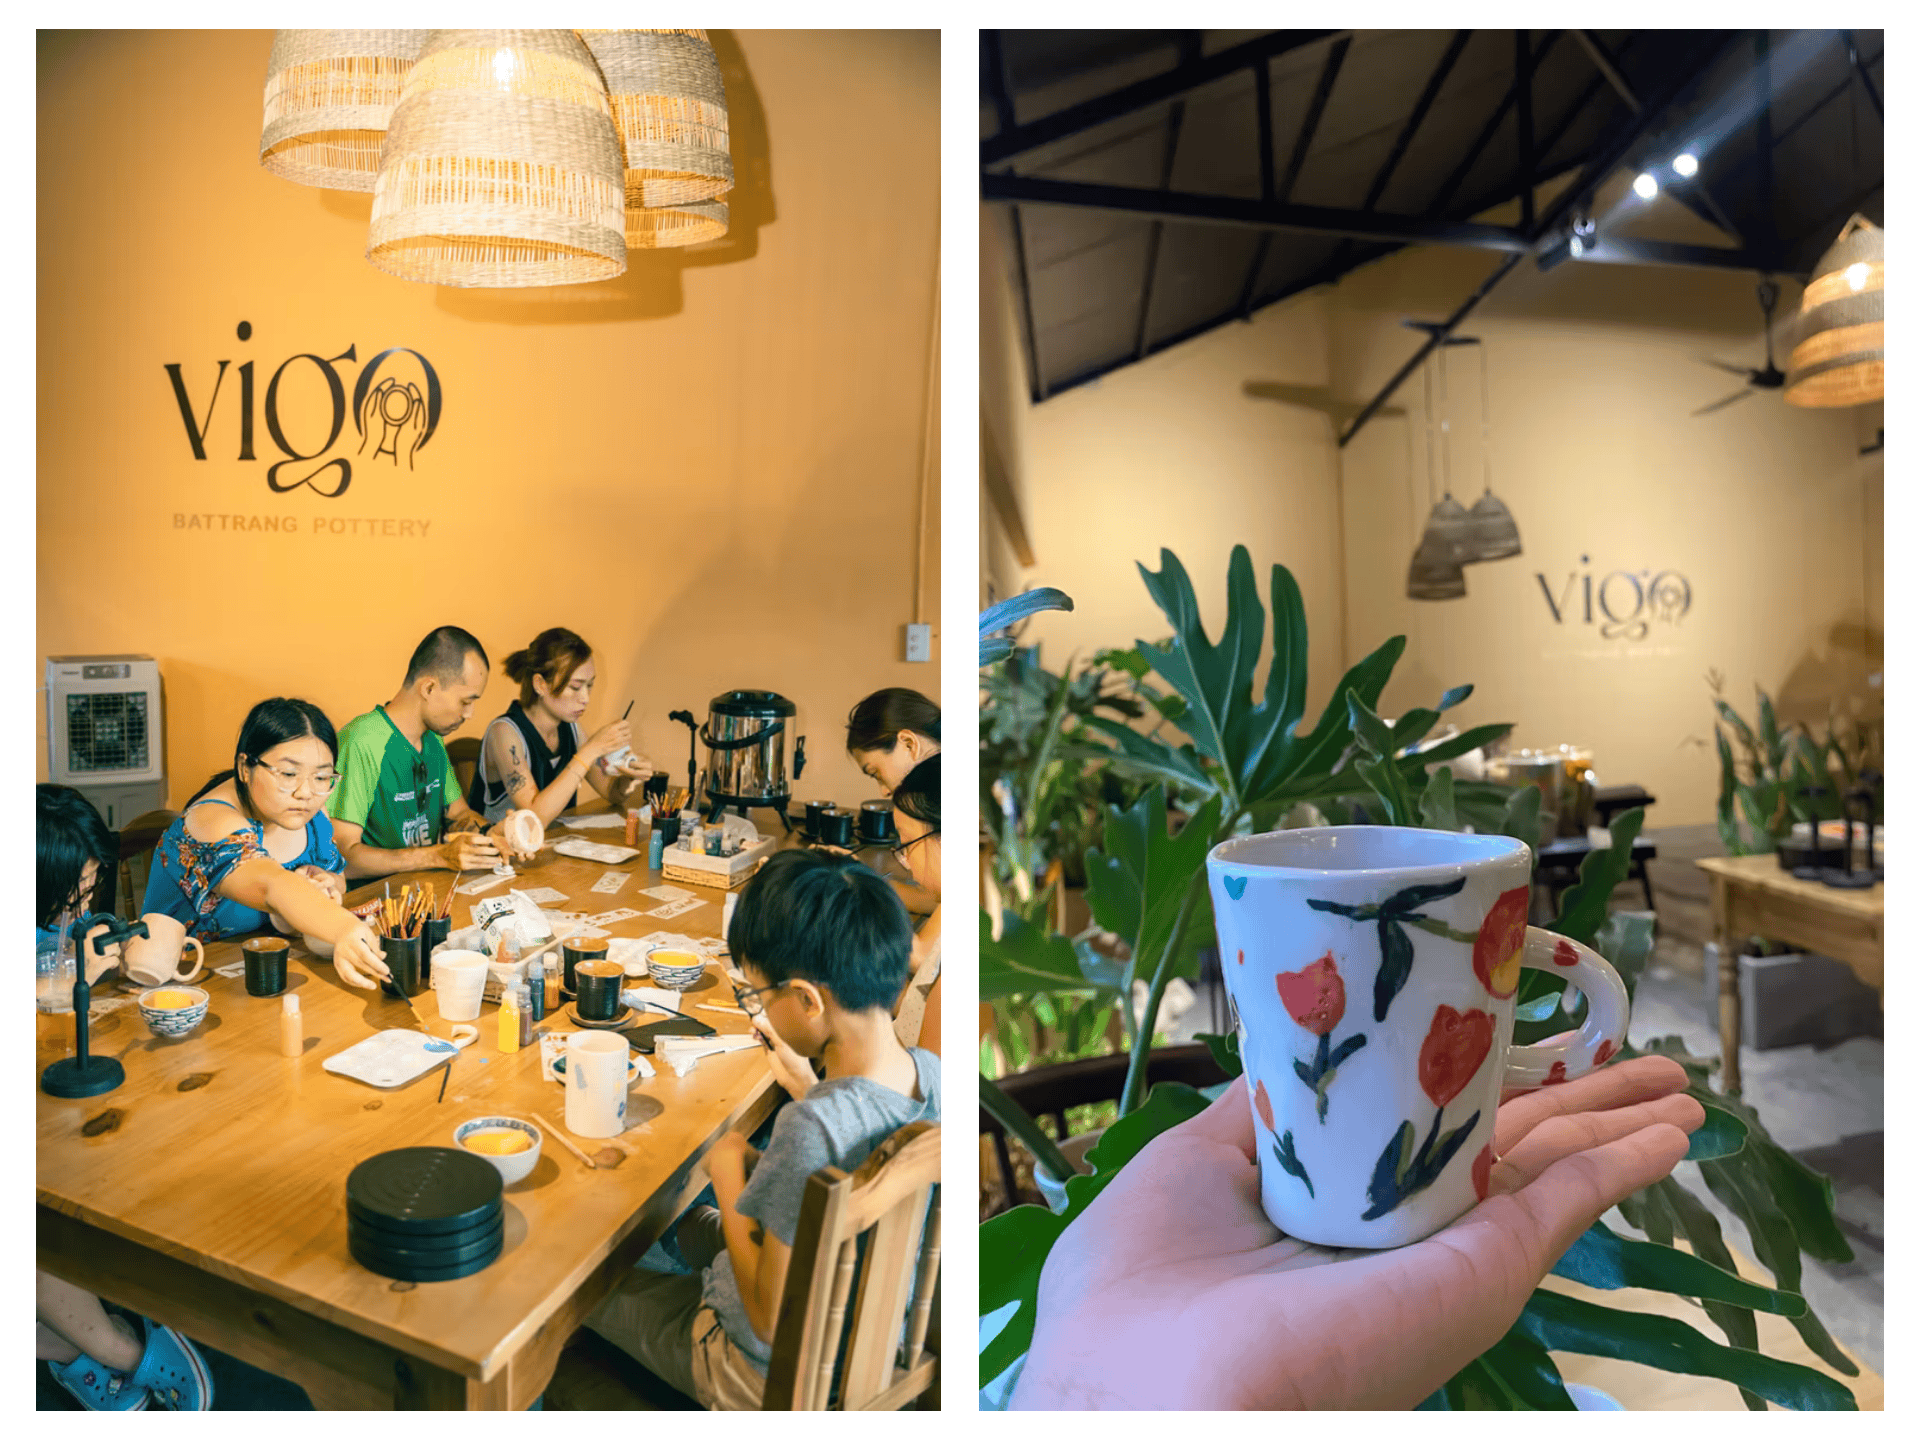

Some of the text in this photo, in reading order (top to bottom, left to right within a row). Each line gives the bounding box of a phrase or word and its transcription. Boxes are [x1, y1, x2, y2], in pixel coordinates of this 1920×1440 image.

[163, 320, 443, 497] vigo
[172, 513, 431, 537] BATTRANG POTTERY
[1535, 553, 1693, 642] vigo
